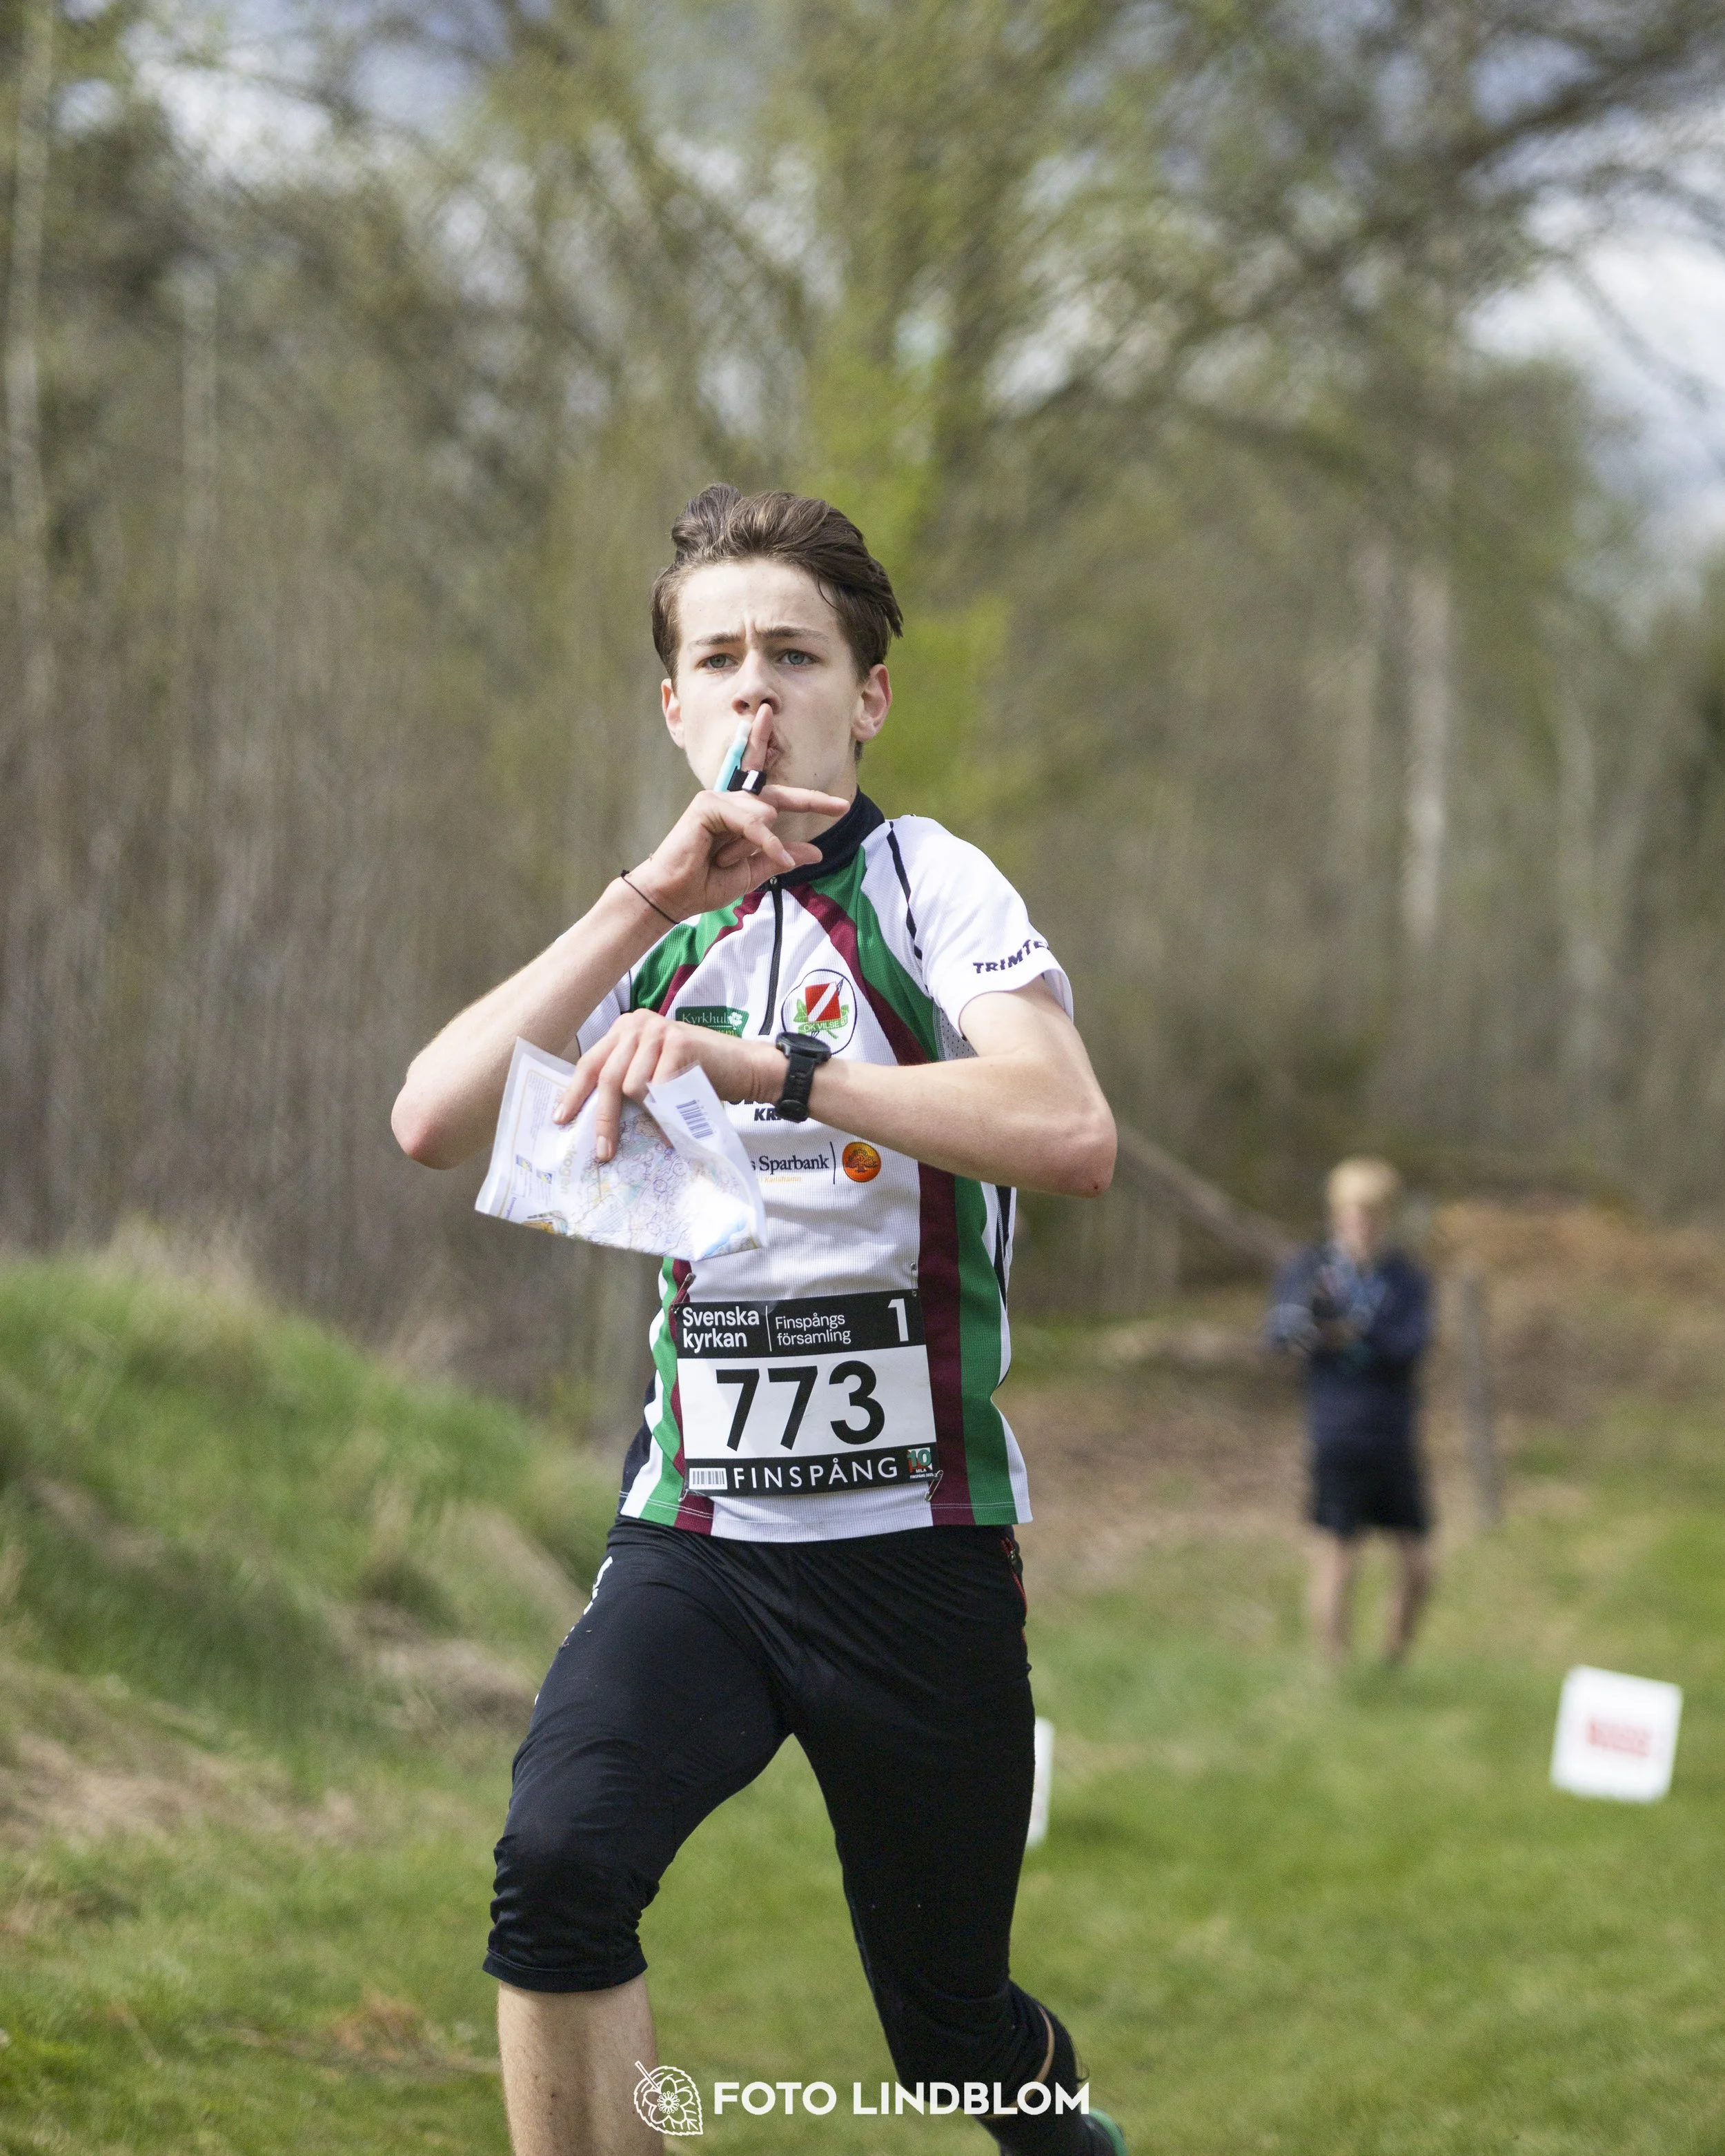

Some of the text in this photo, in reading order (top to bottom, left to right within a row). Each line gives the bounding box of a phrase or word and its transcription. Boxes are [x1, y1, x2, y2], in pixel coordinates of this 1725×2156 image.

[973, 939, 1049, 974] TRIMTE
[682, 1012, 729, 1025] Kyrkhul
[803, 1023, 816, 1031] OK
[818, 1020, 840, 1029] VILSE
[758, 1154, 830, 1175] Sparbank
[682, 1306, 760, 1326] Svenska
[775, 1312, 845, 1331] Finspångs
[887, 1298, 909, 1342] 1
[683, 1327, 748, 1354] kyrkan
[777, 1329, 851, 1346] församling
[716, 1360, 885, 1452] 773
[907, 1449, 931, 1467] 10
[733, 1456, 898, 1489] FINSPÅNG
